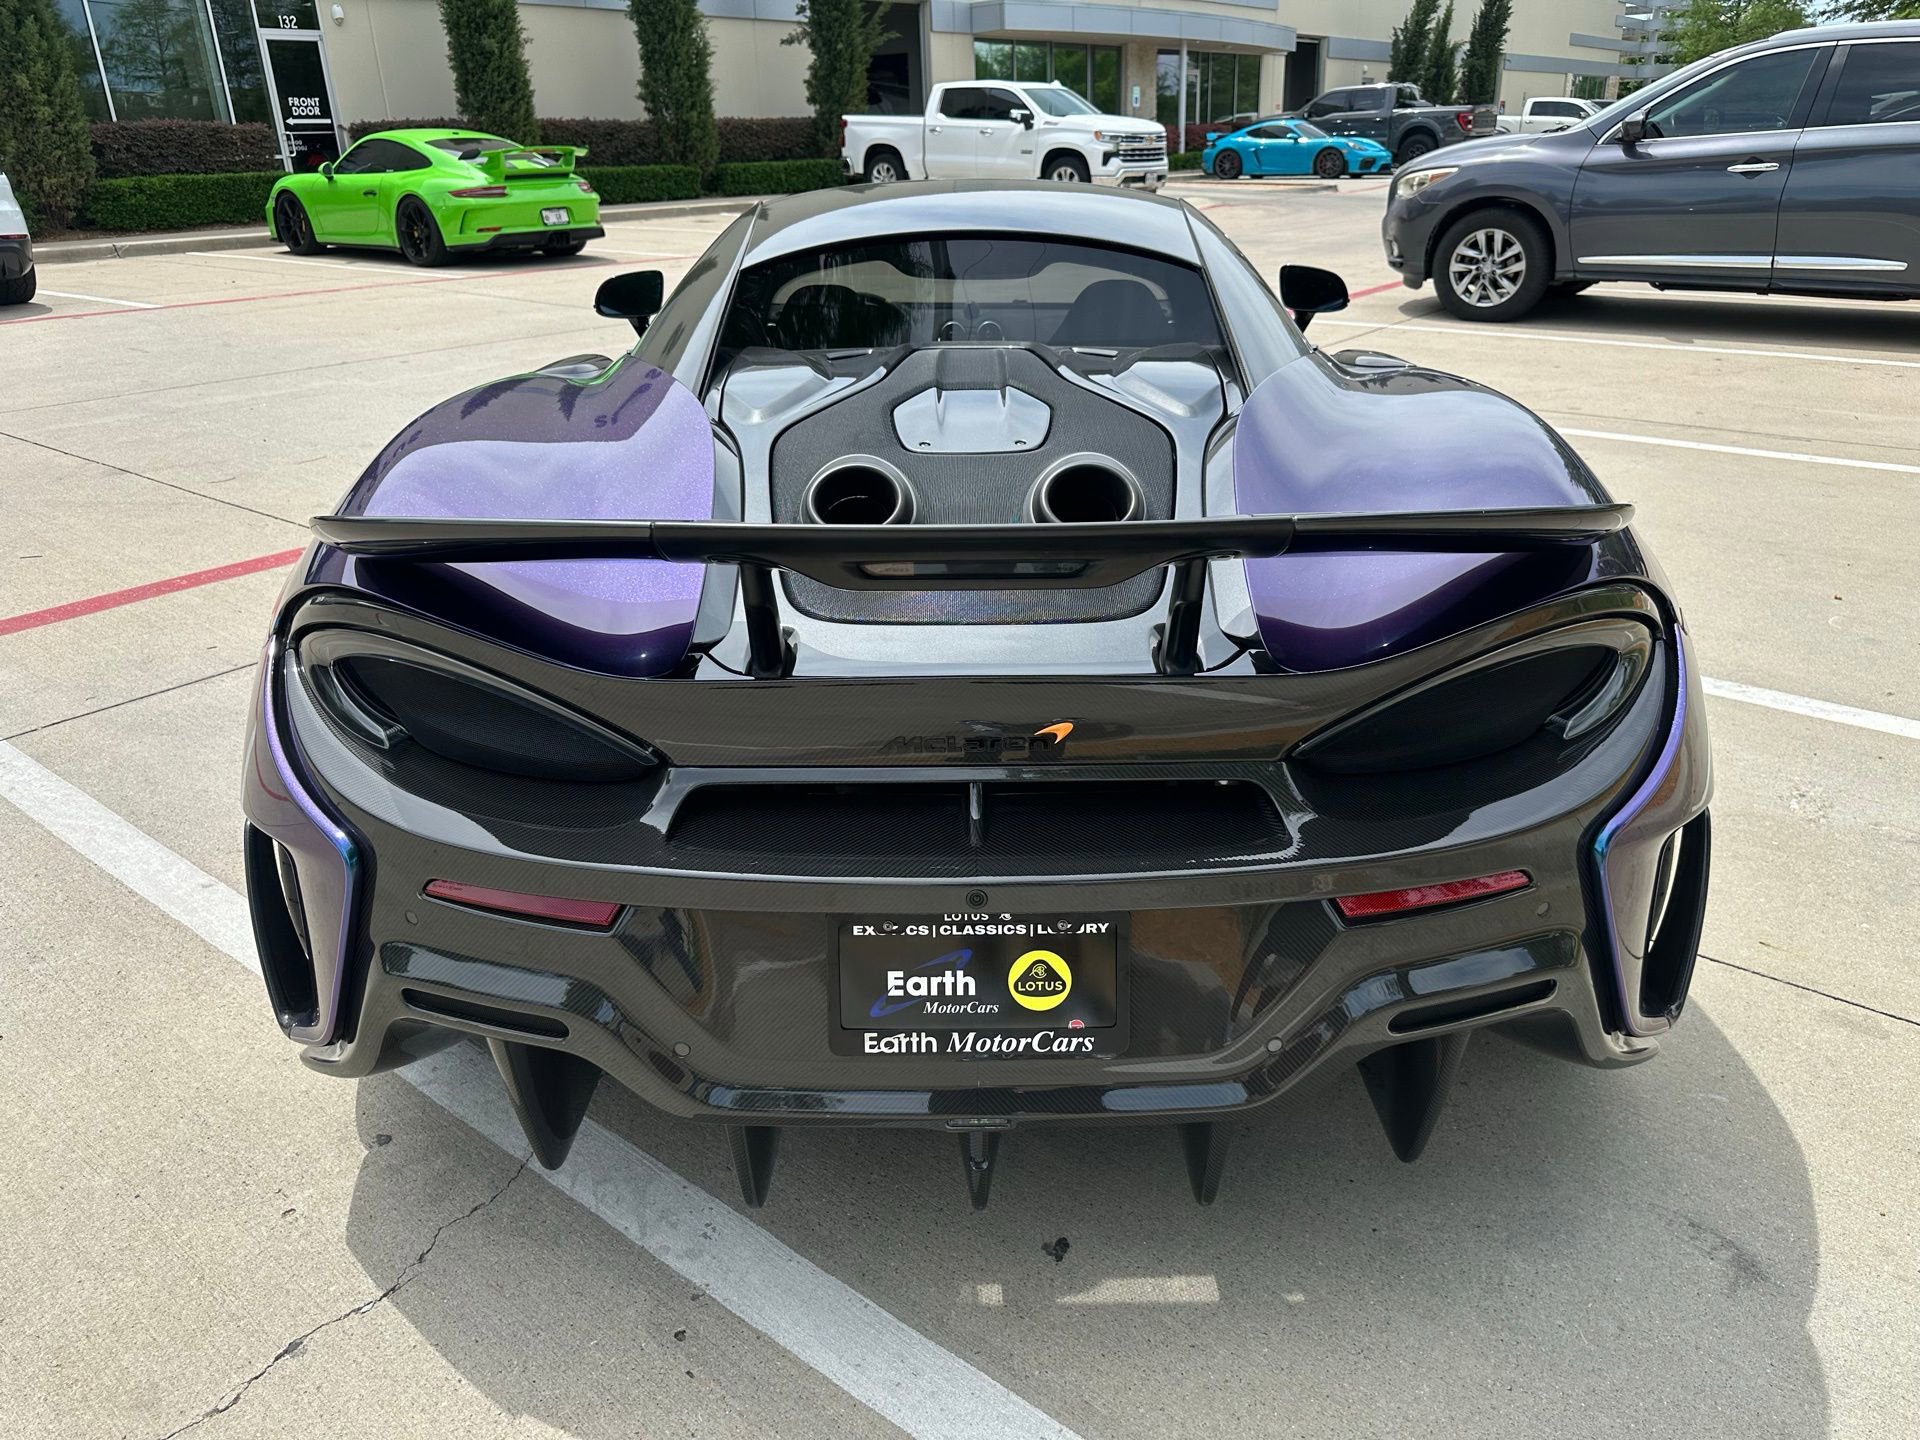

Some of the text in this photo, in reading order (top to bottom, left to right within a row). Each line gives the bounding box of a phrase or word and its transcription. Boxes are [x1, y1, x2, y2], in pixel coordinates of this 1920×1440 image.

[278, 15, 298, 29] 132
[288, 97, 320, 107] FRONT
[292, 106, 321, 116] DOOR
[852, 925, 930, 936] EXCS
[939, 924, 1027, 936] CLASSICS
[887, 970, 976, 996] Earth
[1017, 981, 1063, 992] LOTUS
[923, 1001, 1000, 1014] MotorCars
[864, 1030, 1095, 1054] Earth MotorCars
